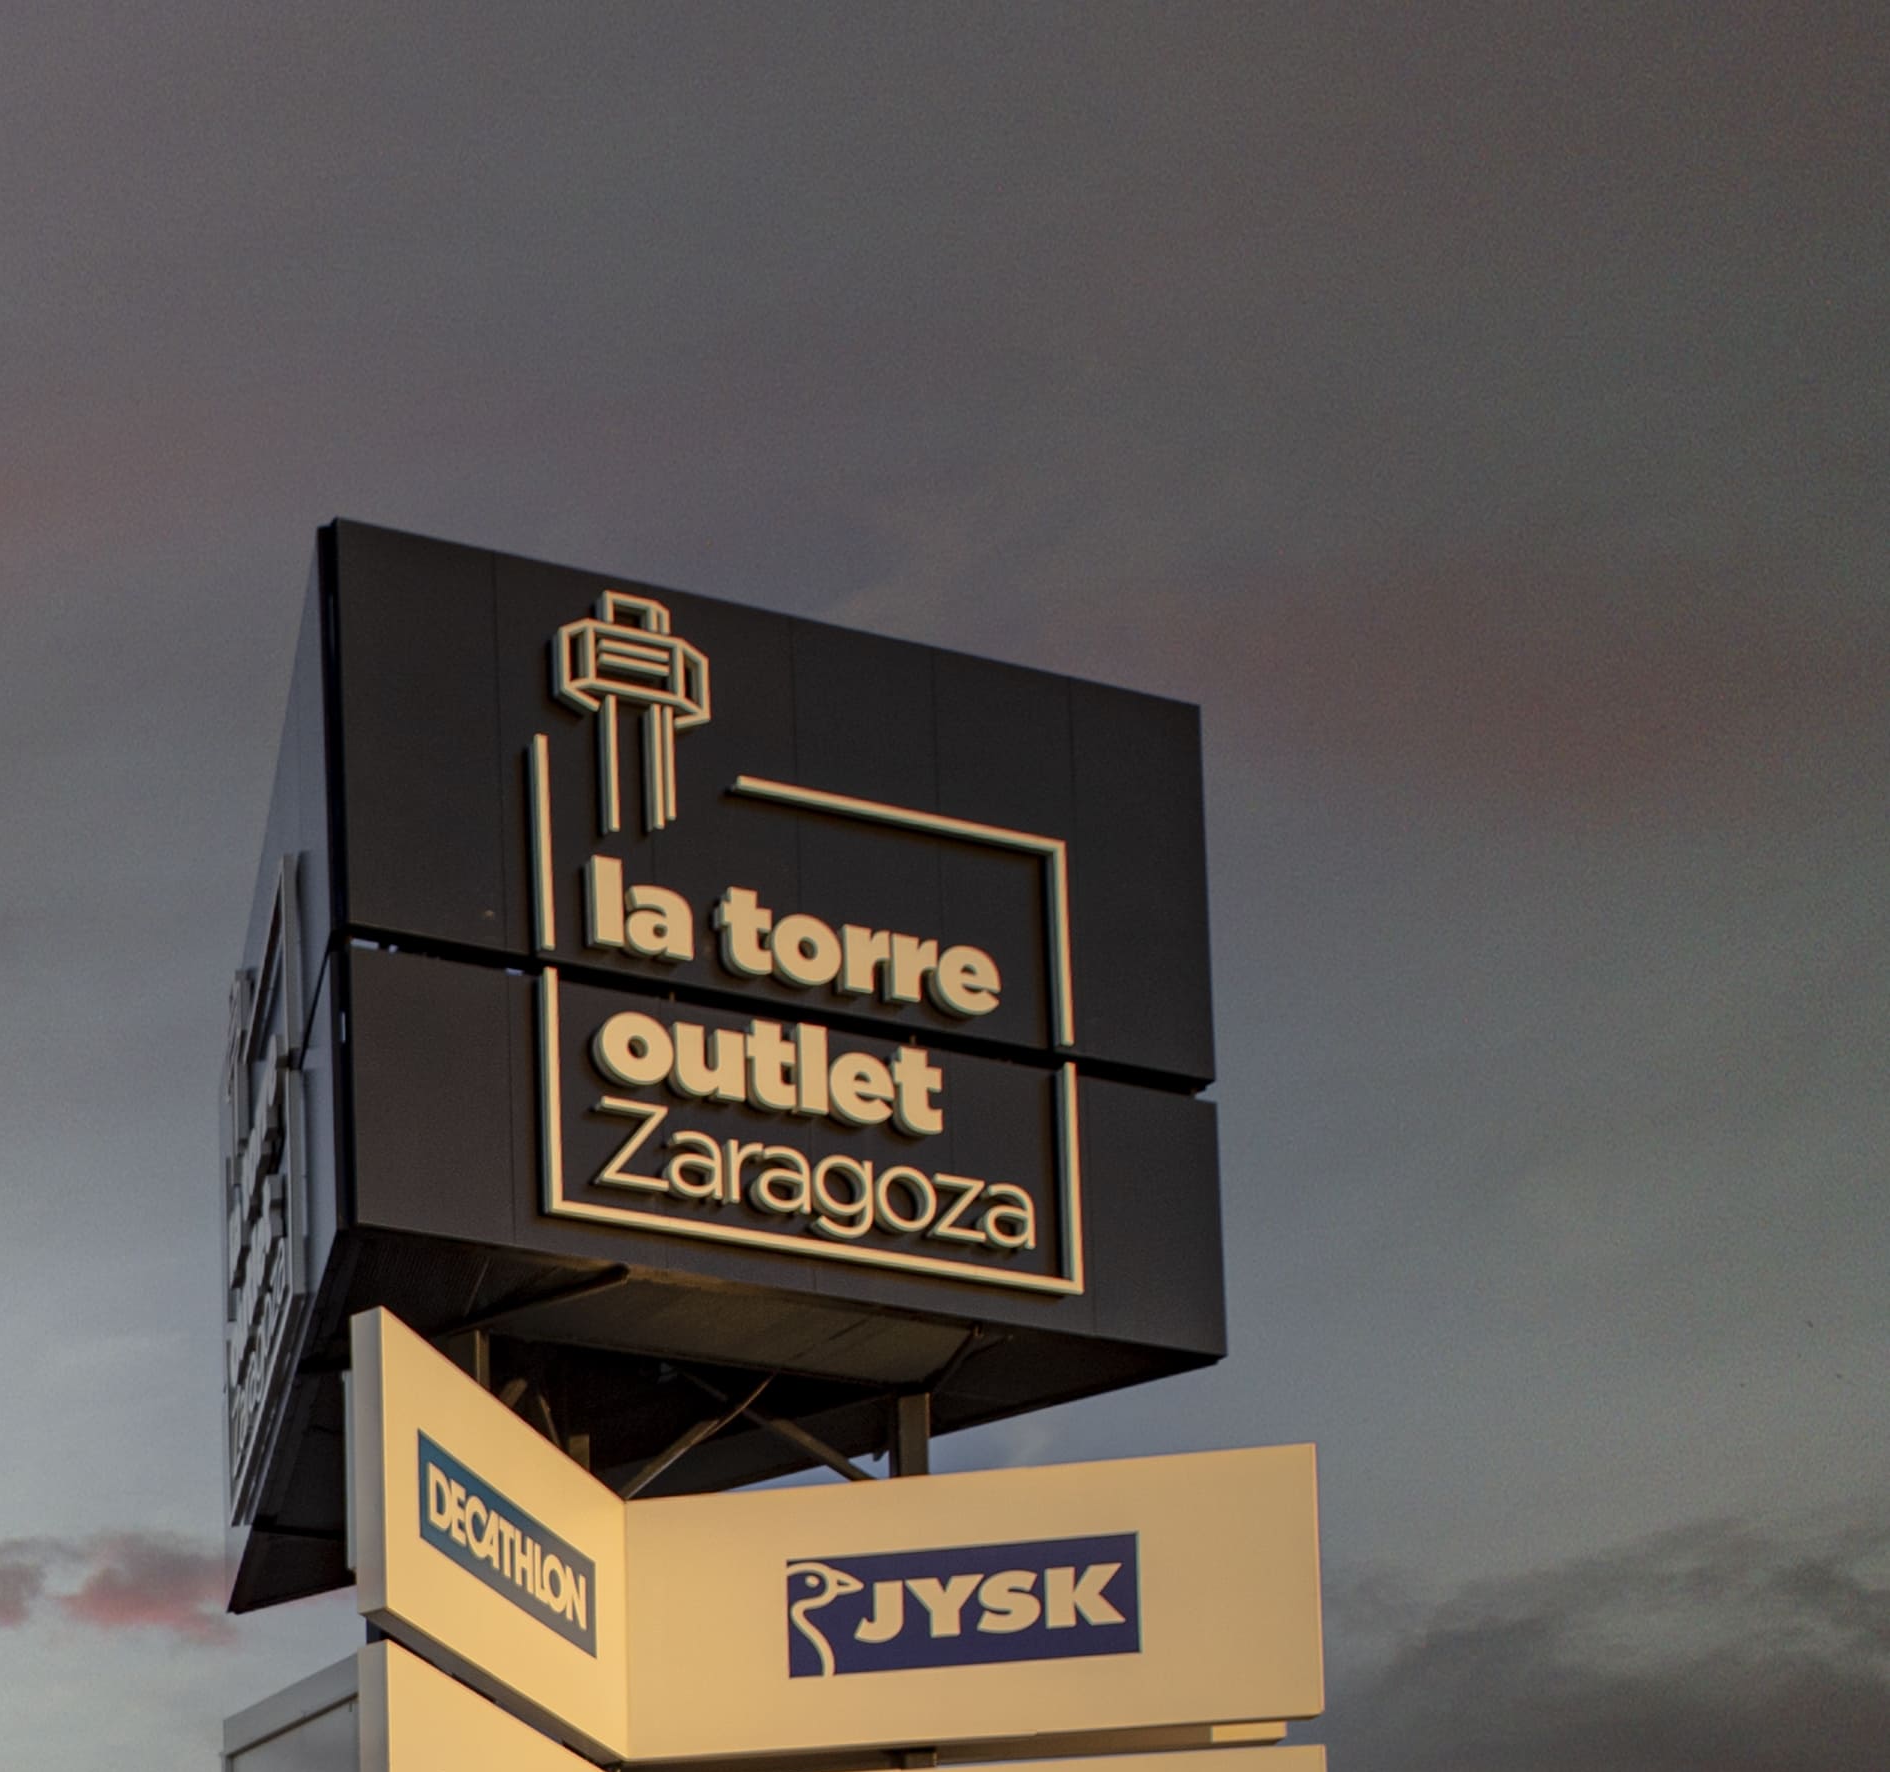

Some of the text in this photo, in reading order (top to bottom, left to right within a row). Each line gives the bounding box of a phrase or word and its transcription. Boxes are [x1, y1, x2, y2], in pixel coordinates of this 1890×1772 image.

[584, 855, 1000, 1018] la torre
[592, 1011, 943, 1136] outlet
[594, 1095, 1036, 1250] Zaragoza
[429, 1461, 587, 1631] DECATHLON
[854, 1562, 1126, 1644] JYSK
